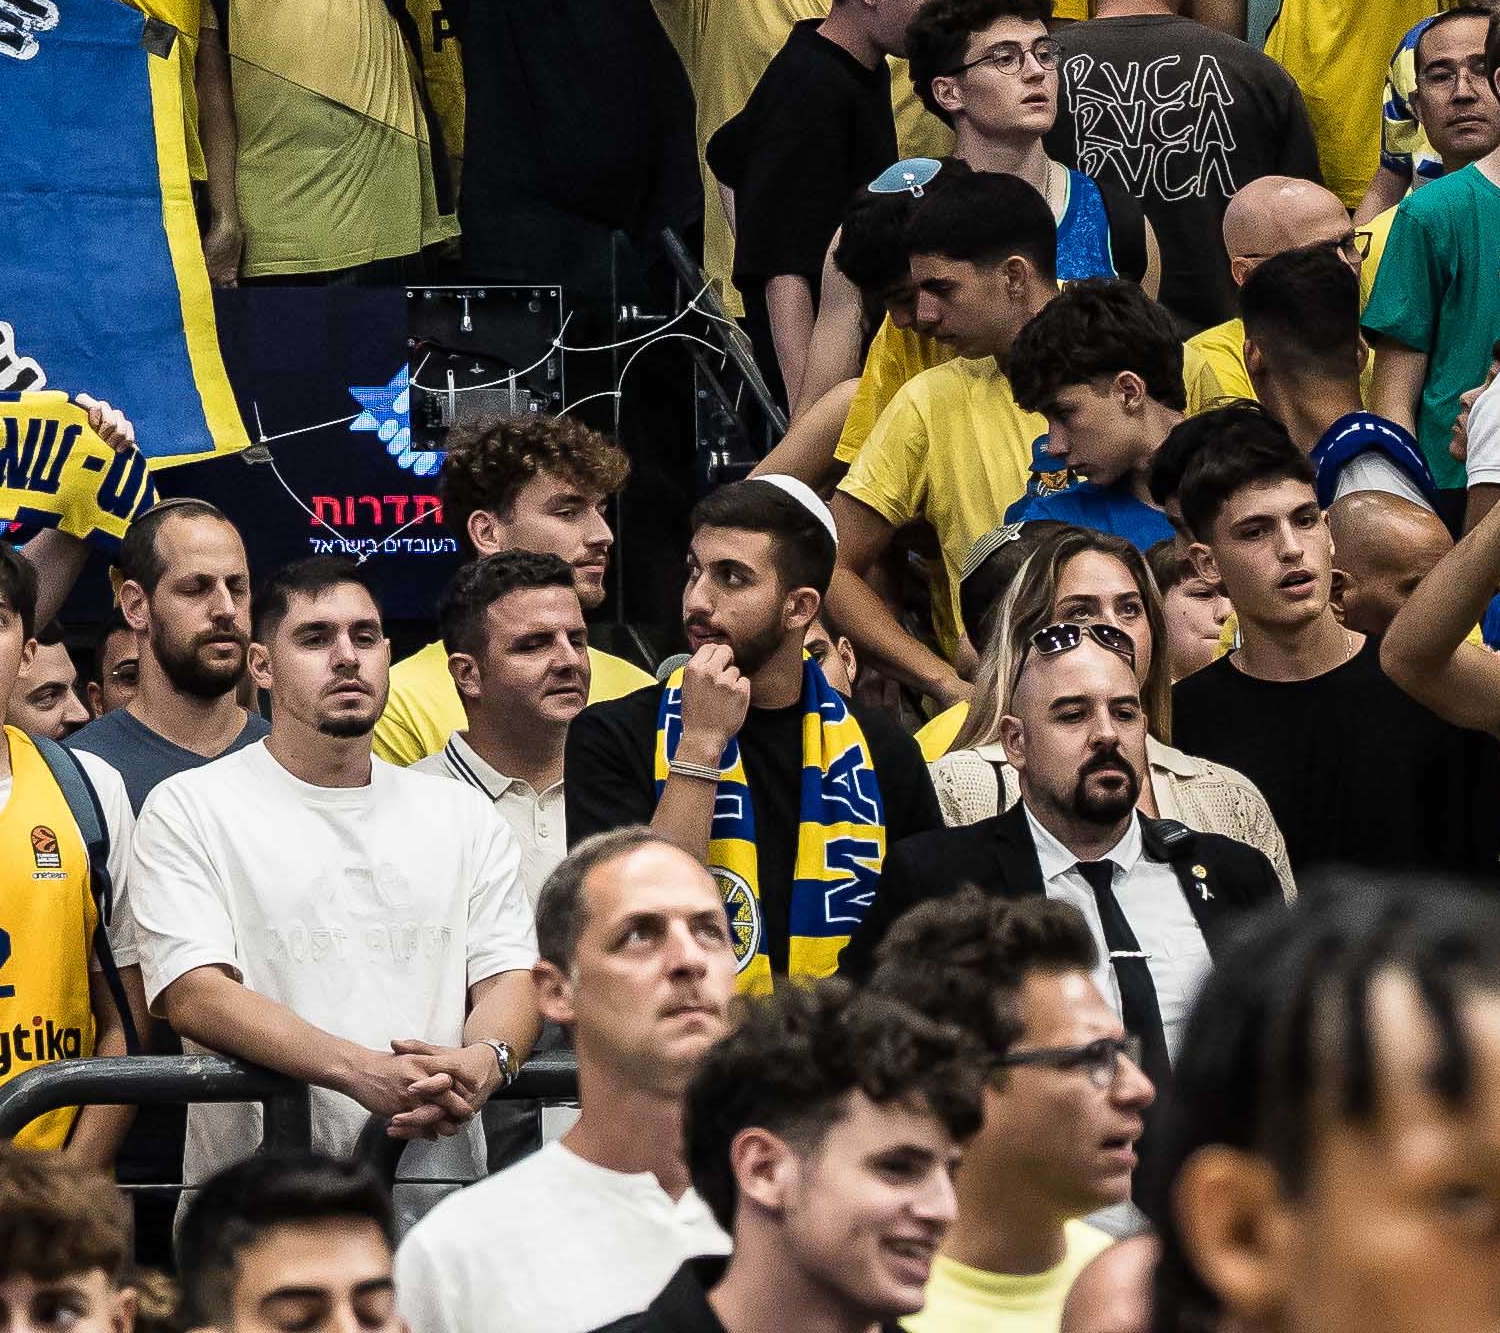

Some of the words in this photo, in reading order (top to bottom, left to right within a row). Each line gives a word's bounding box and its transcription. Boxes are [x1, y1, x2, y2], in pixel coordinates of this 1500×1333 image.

[1065, 52, 1236, 113] RVCA
[1075, 99, 1237, 152] RVCA
[1078, 142, 1239, 201] RVCA
